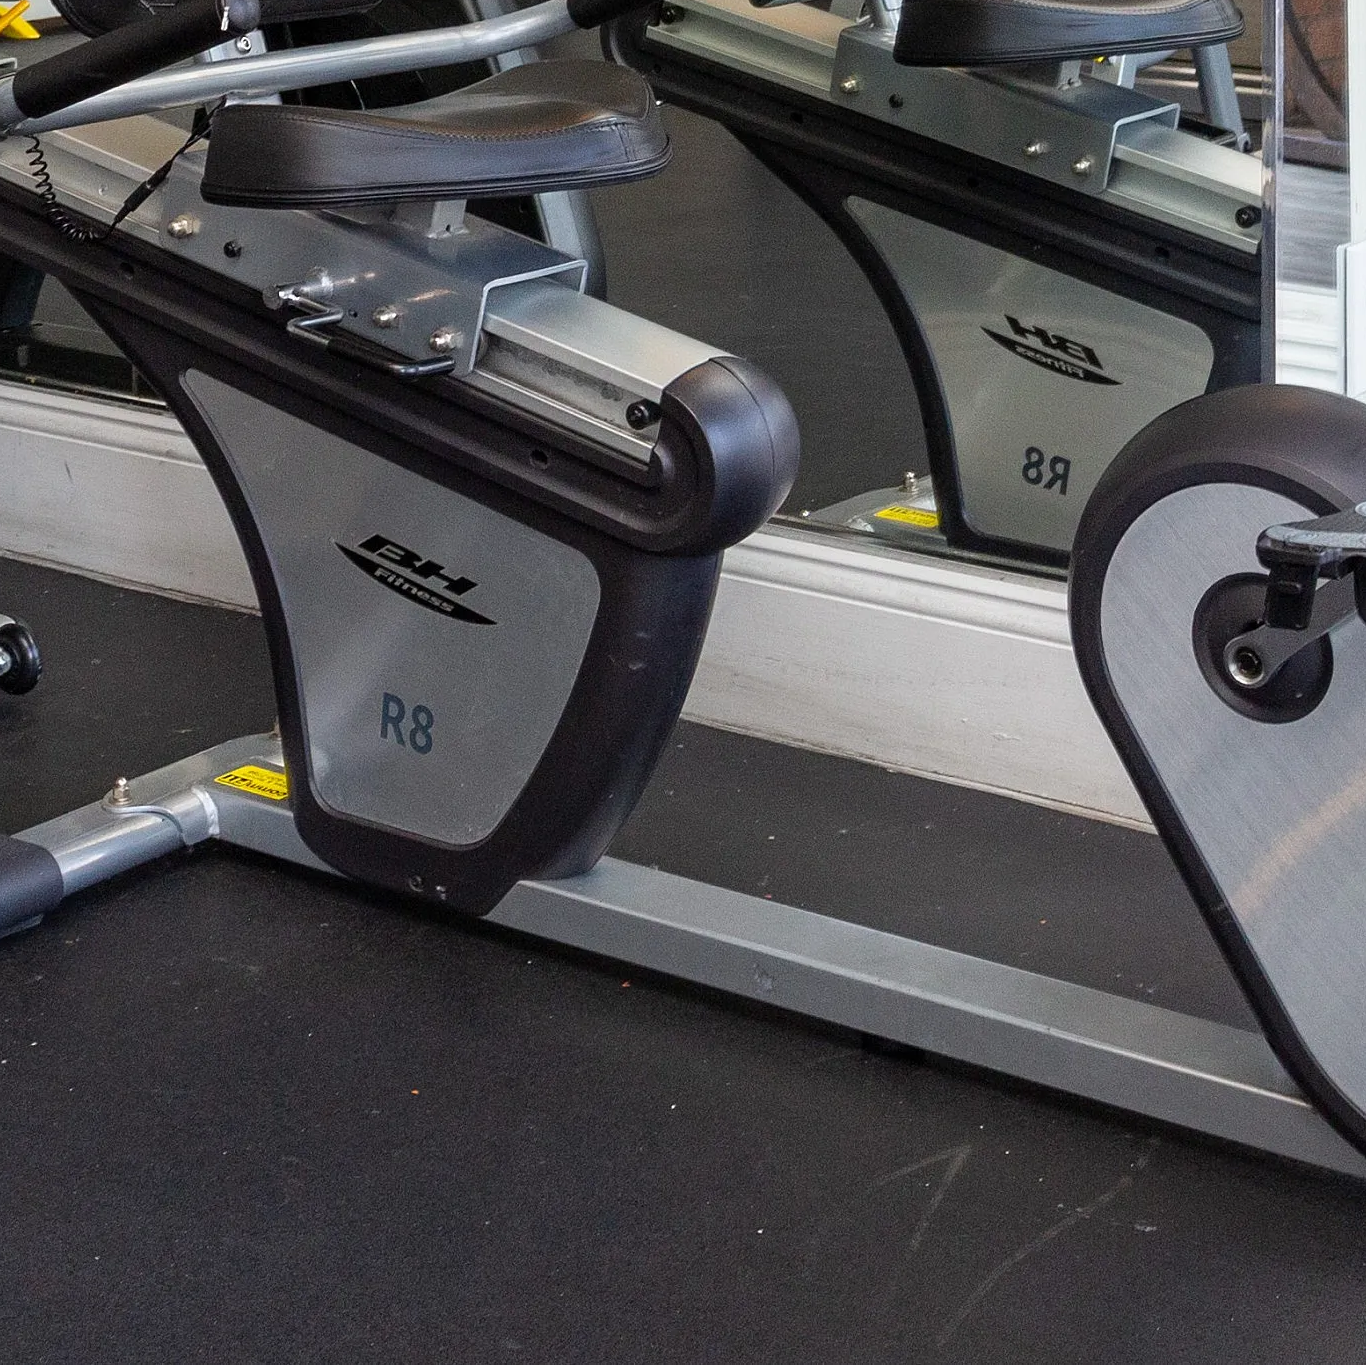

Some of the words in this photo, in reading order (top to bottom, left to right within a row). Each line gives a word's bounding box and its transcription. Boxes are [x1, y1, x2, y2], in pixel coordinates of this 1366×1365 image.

[358, 533, 479, 596] BH
[374, 567, 455, 612] Fitness
[380, 692, 434, 755] R8
